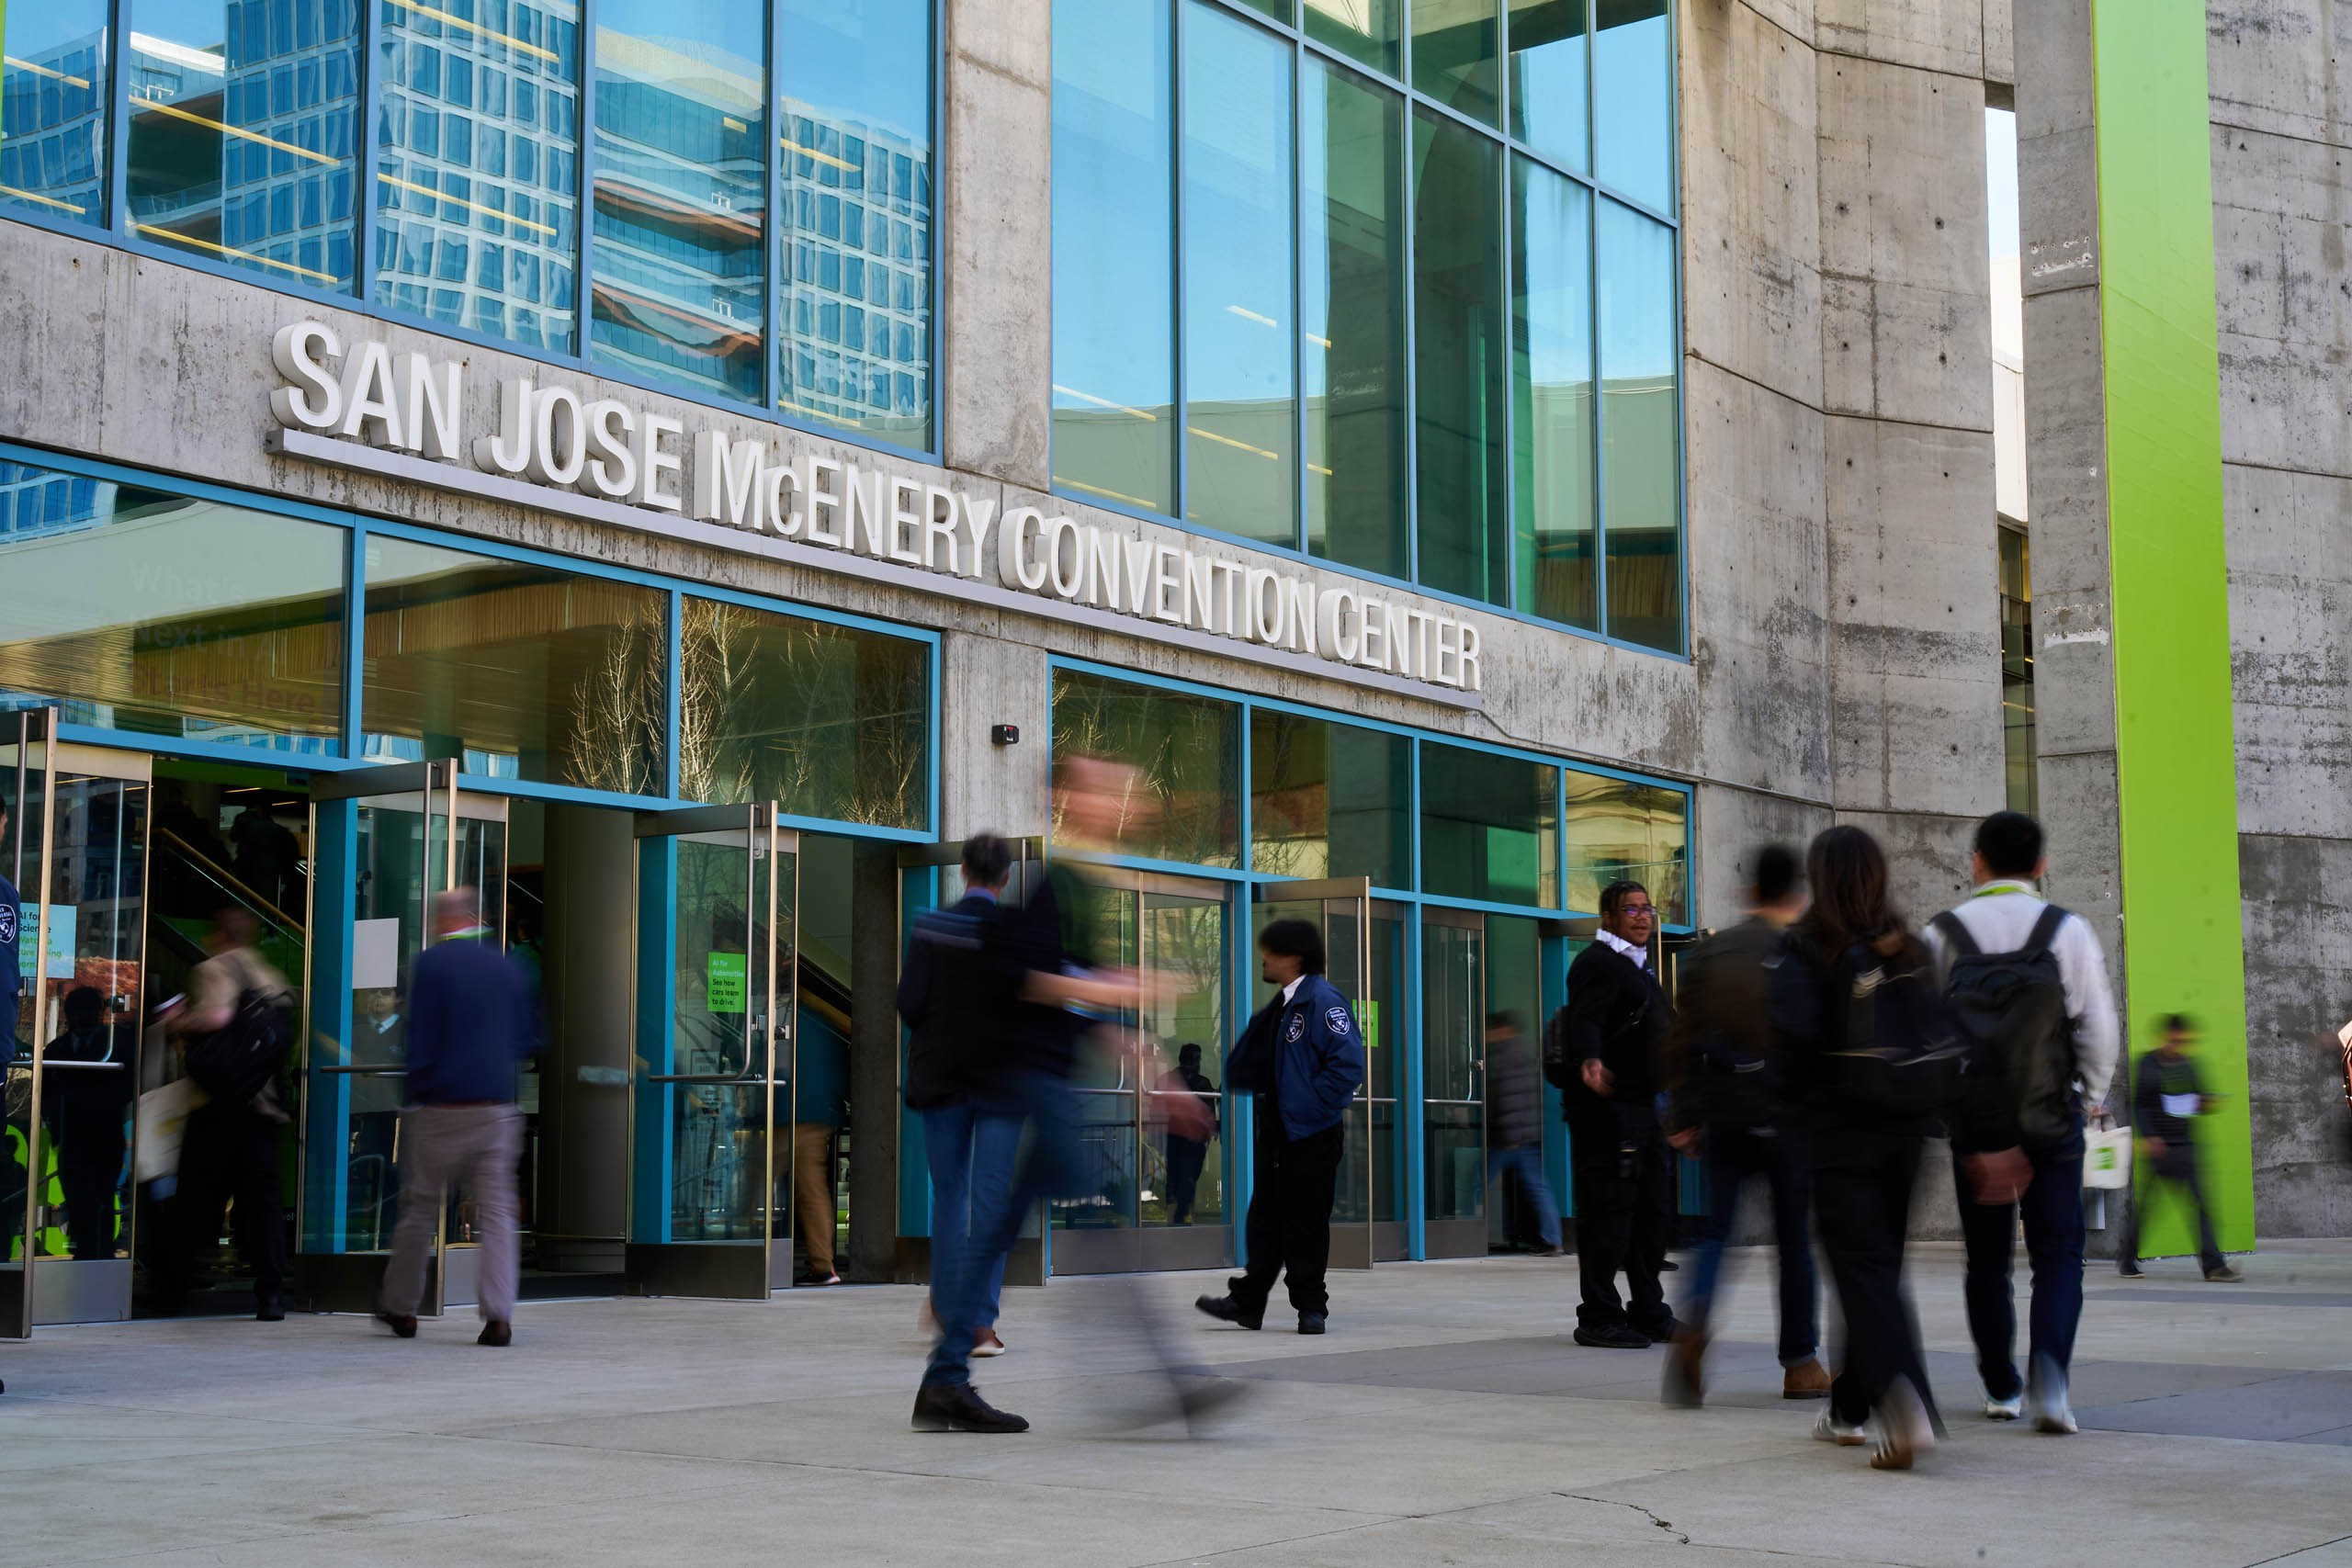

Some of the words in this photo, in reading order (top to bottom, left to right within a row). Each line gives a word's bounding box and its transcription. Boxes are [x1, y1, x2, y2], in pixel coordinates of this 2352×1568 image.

[271, 321, 460, 459] SAN
[473, 378, 684, 513] JOSE
[695, 430, 996, 579] McENERY
[998, 506, 1316, 654] CONVENTION
[1317, 587, 1481, 692] CENTER
[130, 610, 207, 654] Next
[217, 625, 244, 658] in
[18, 923, 51, 933] Sciene
[724, 978, 735, 987] how
